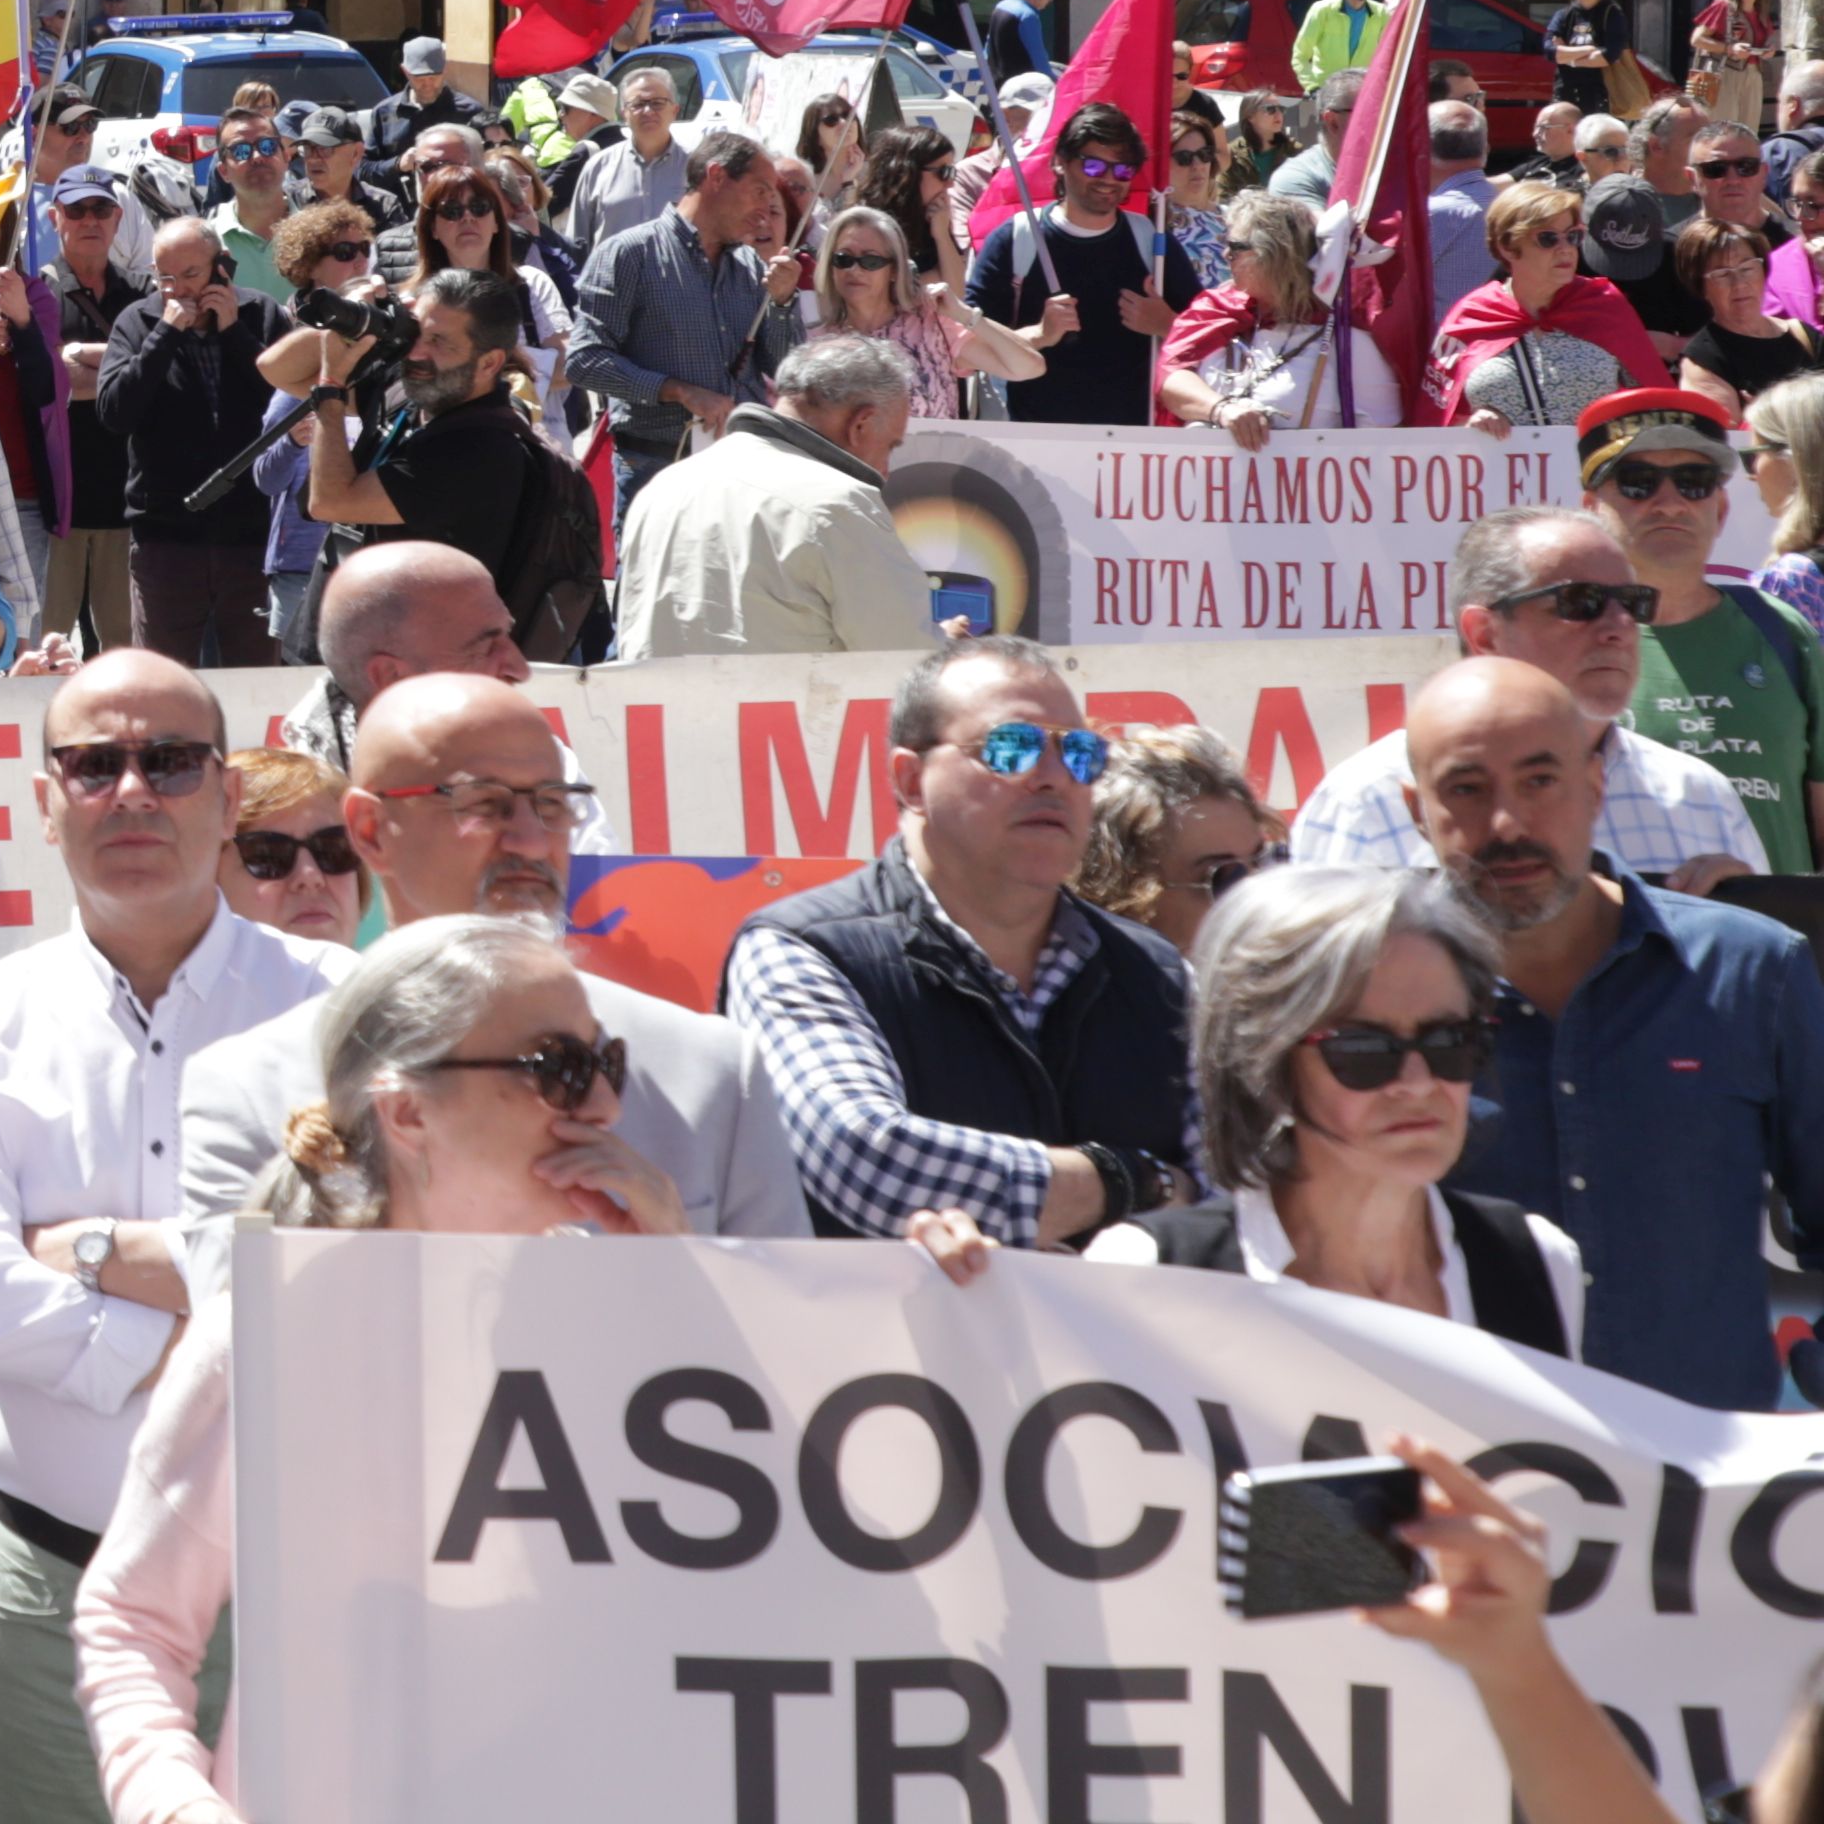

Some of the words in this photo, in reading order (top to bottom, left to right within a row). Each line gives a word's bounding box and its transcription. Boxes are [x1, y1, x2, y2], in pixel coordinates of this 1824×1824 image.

[1095, 452, 1373, 524] ¡LUCHAMOS
[1391, 453, 1485, 524] POR
[1505, 452, 1562, 508] EL
[1093, 557, 1222, 629] RUTA
[1241, 561, 1302, 630] DE
[1320, 561, 1383, 630] LA
[1656, 695, 1734, 712] RUTA
[1678, 716, 1717, 733] DE
[1677, 737, 1763, 755] PLATA
[674, 1655, 1391, 1824] TREN
